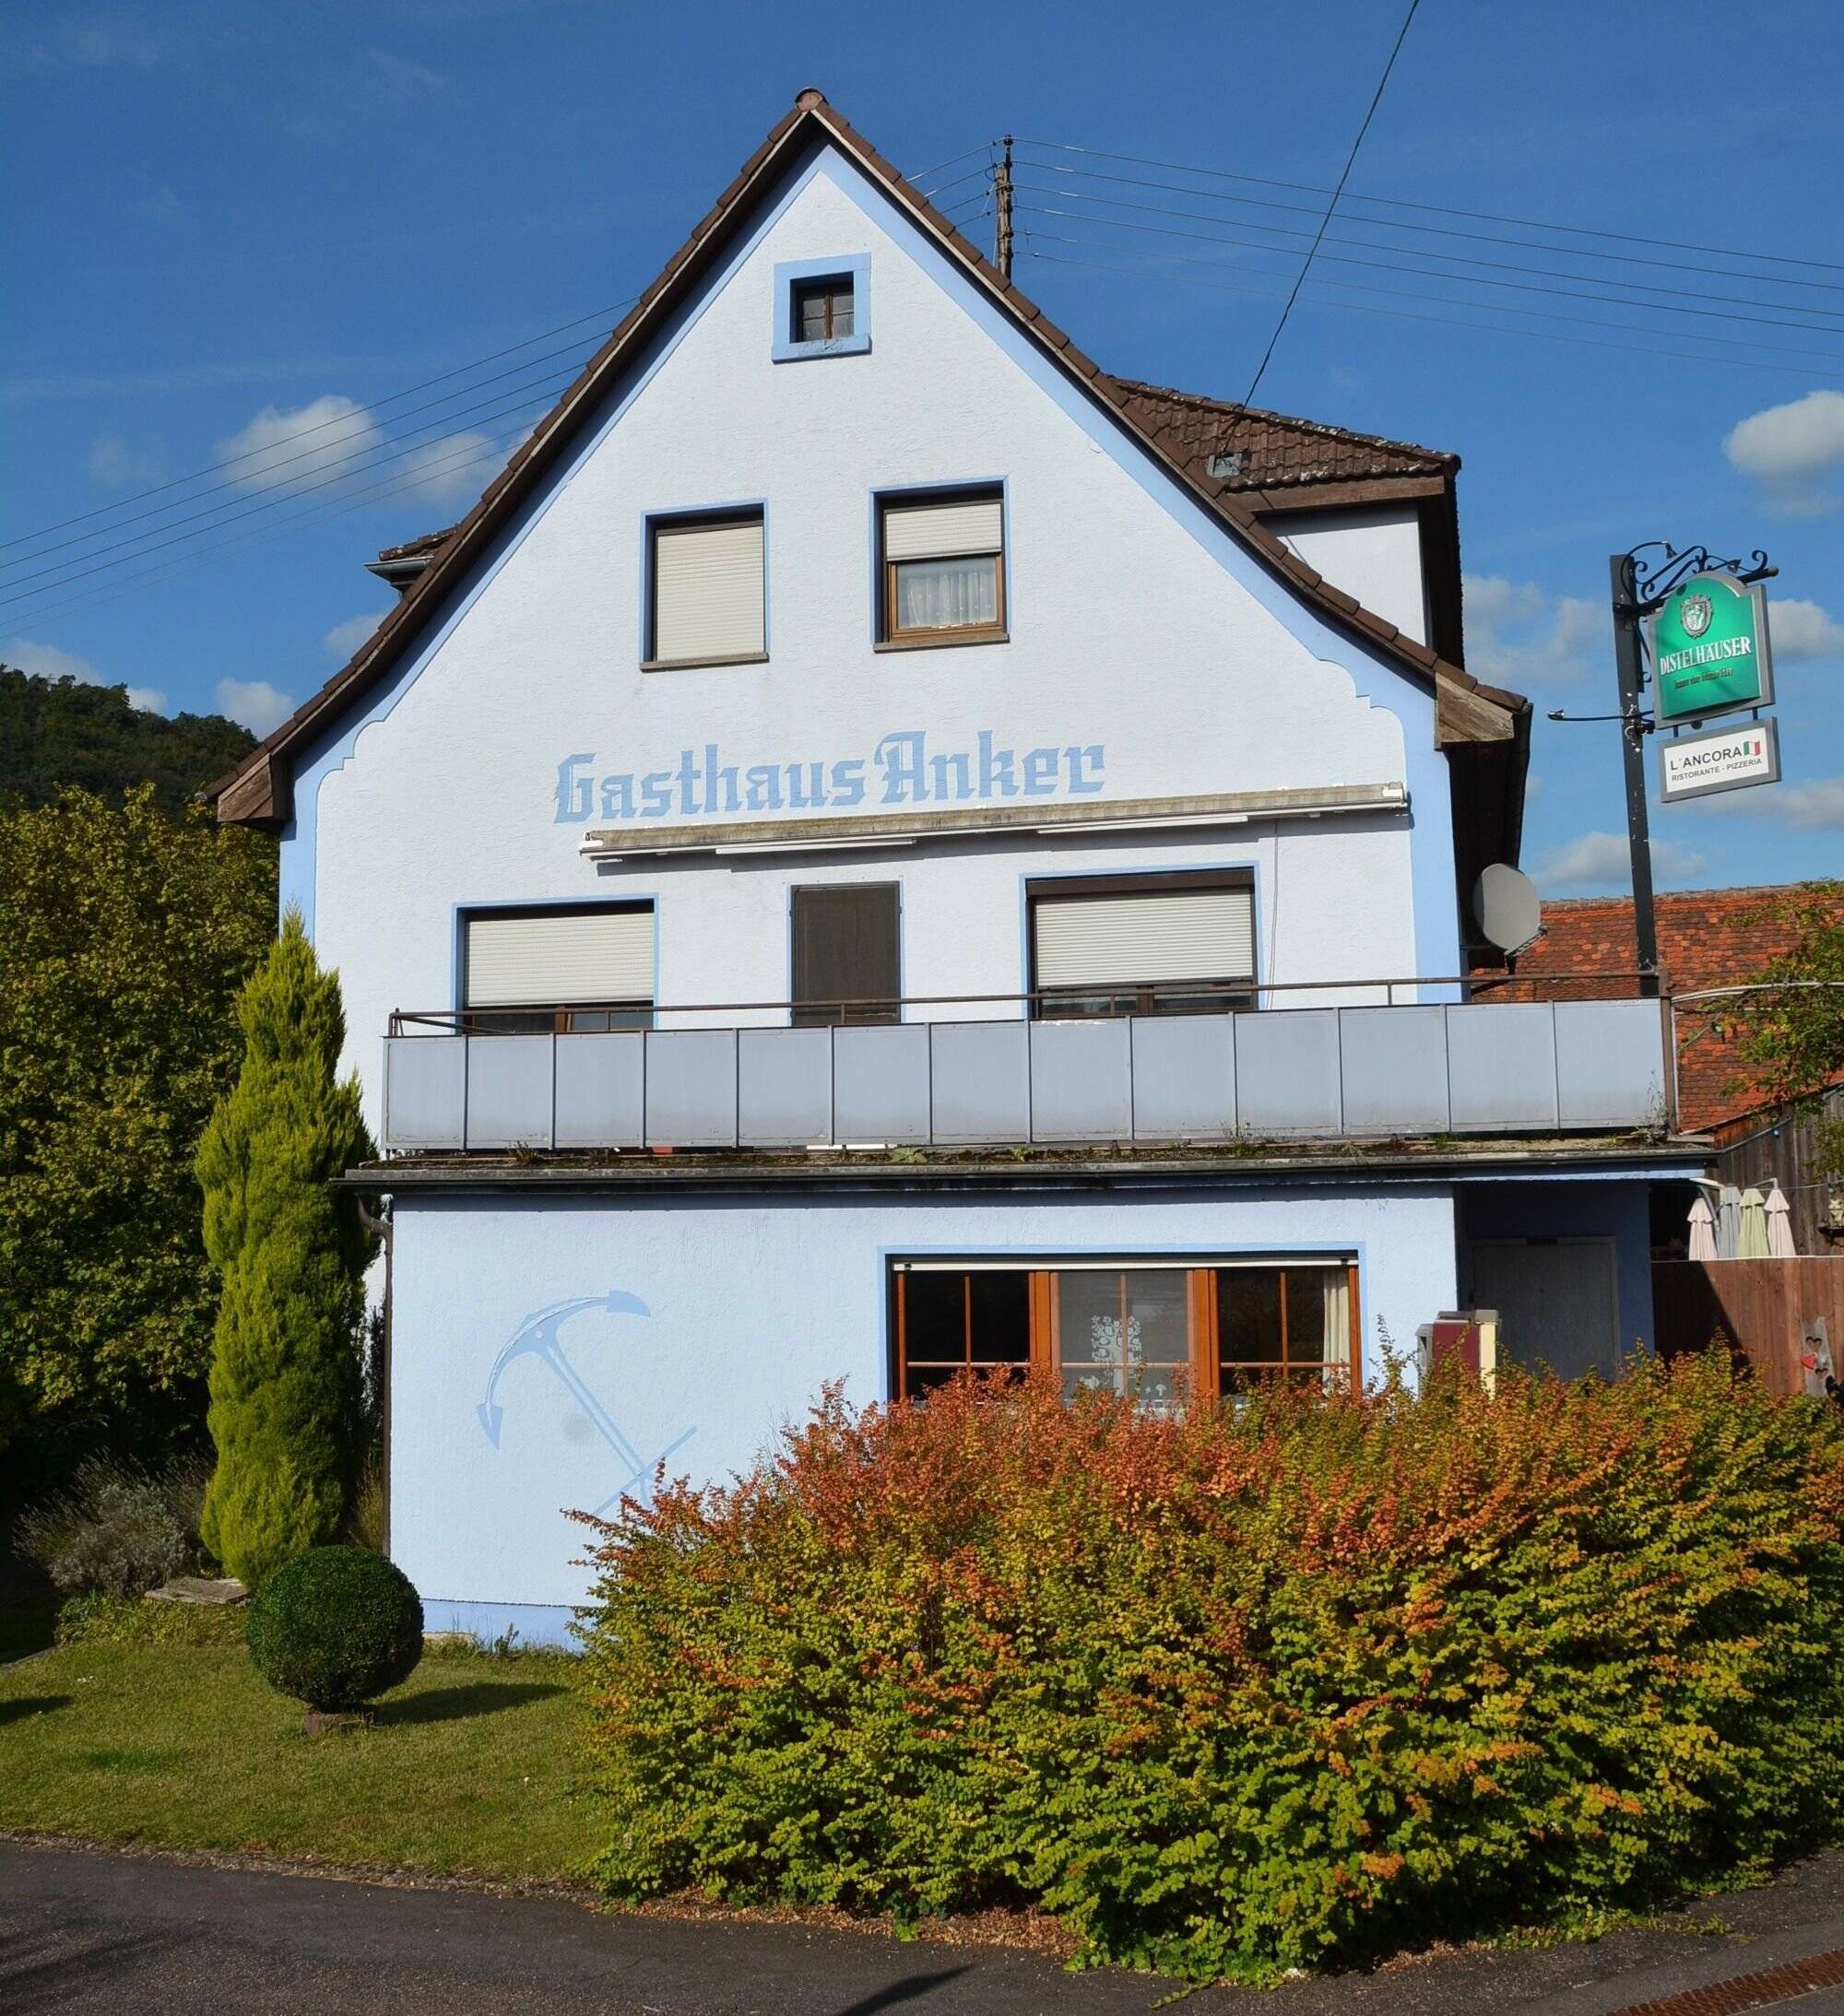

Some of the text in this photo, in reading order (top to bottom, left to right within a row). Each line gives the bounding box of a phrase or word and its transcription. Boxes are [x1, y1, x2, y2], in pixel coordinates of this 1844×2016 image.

[1660, 636, 1752, 676] DISTELHÄUSER
[553, 729, 1105, 824] Gasthaus Anker
[1672, 765, 1720, 783] RISTORANTE
[1725, 758, 1763, 772] PIZZERIA
